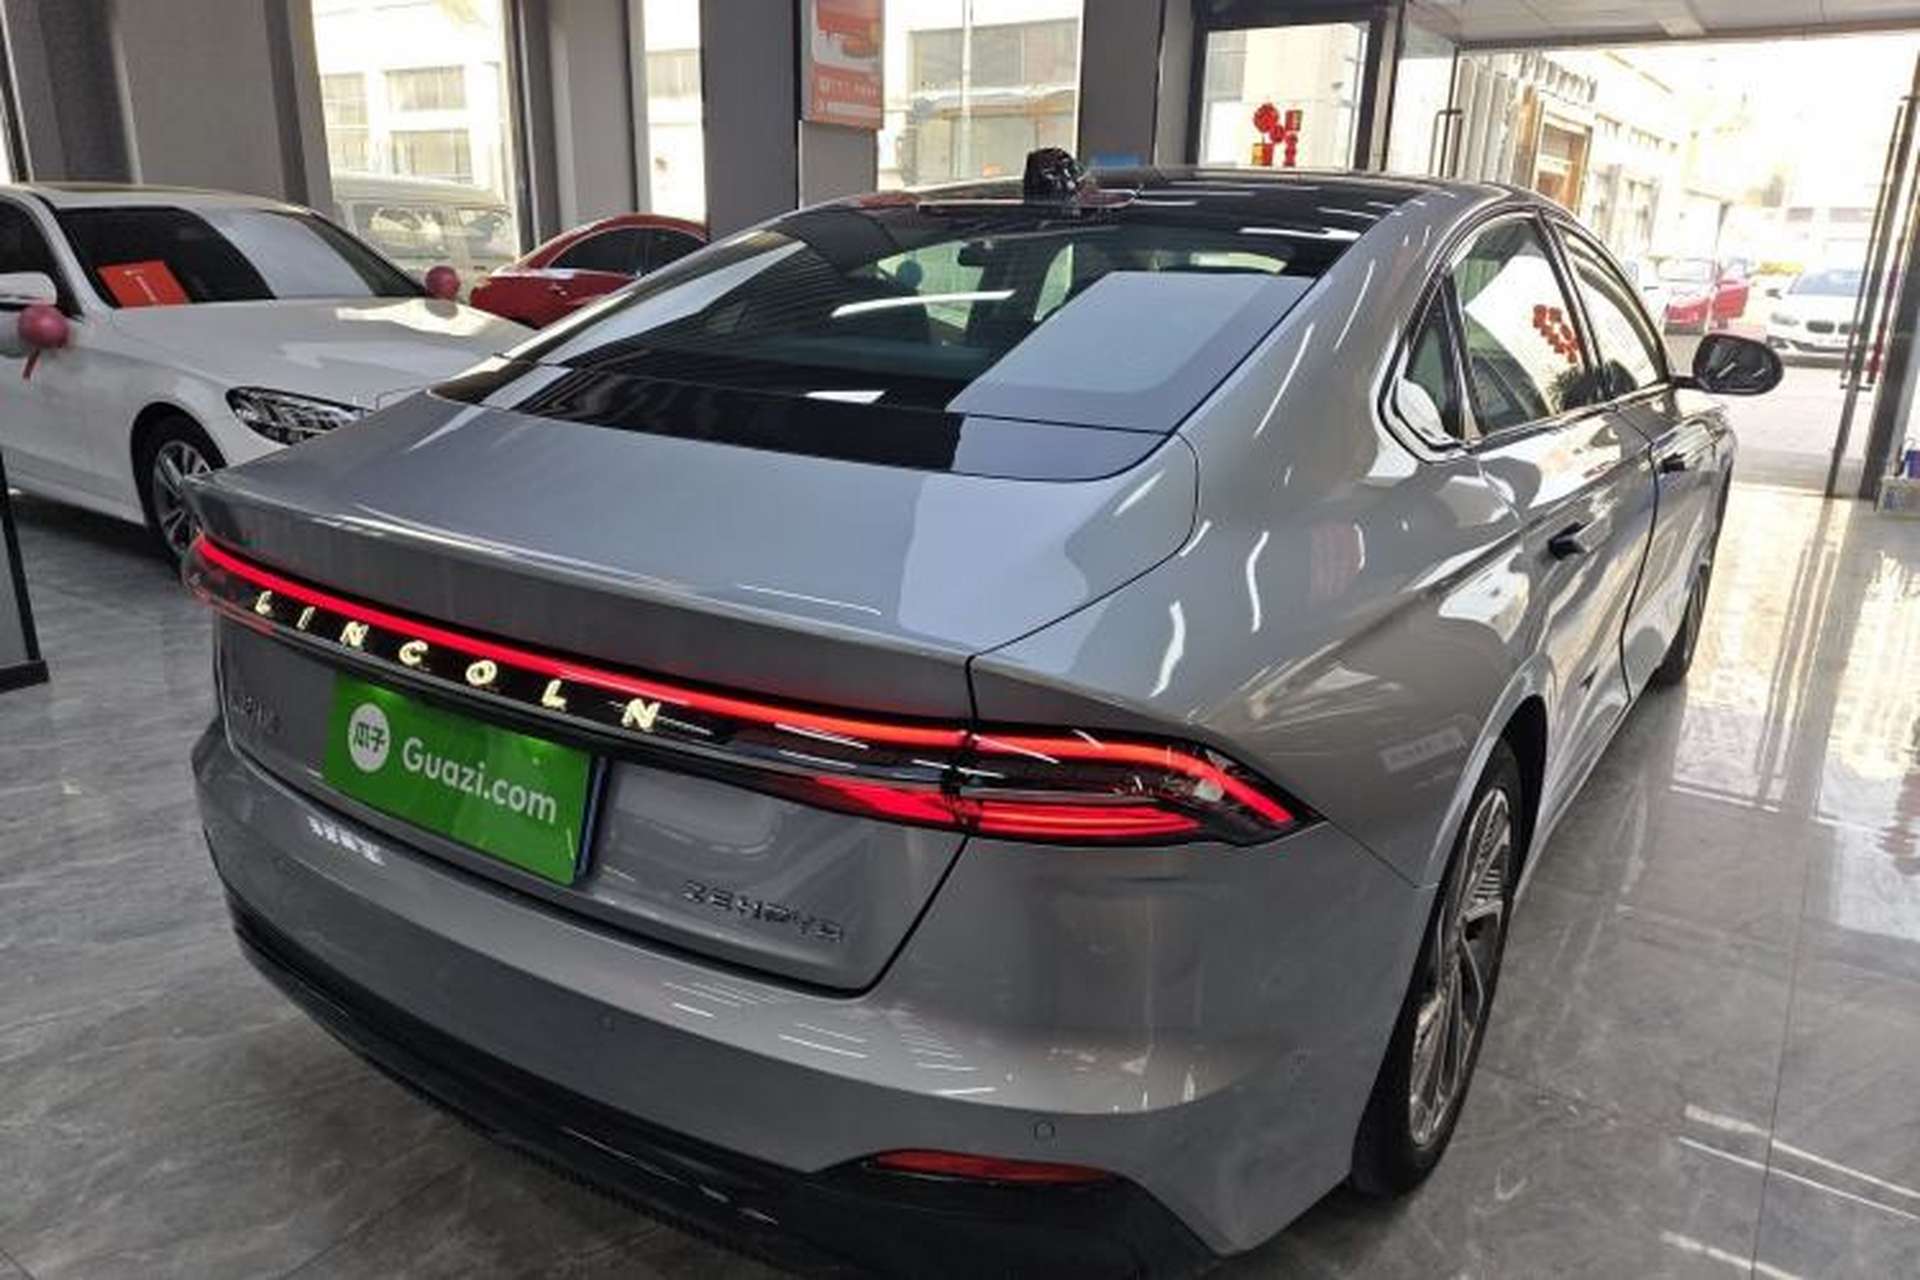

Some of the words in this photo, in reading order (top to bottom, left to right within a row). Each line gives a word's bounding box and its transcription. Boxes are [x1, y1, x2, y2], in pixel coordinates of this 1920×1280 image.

[254, 591, 661, 732] LINCOLN
[354, 721, 387, 753] 瓜子
[403, 737, 557, 824] Guazi.com
